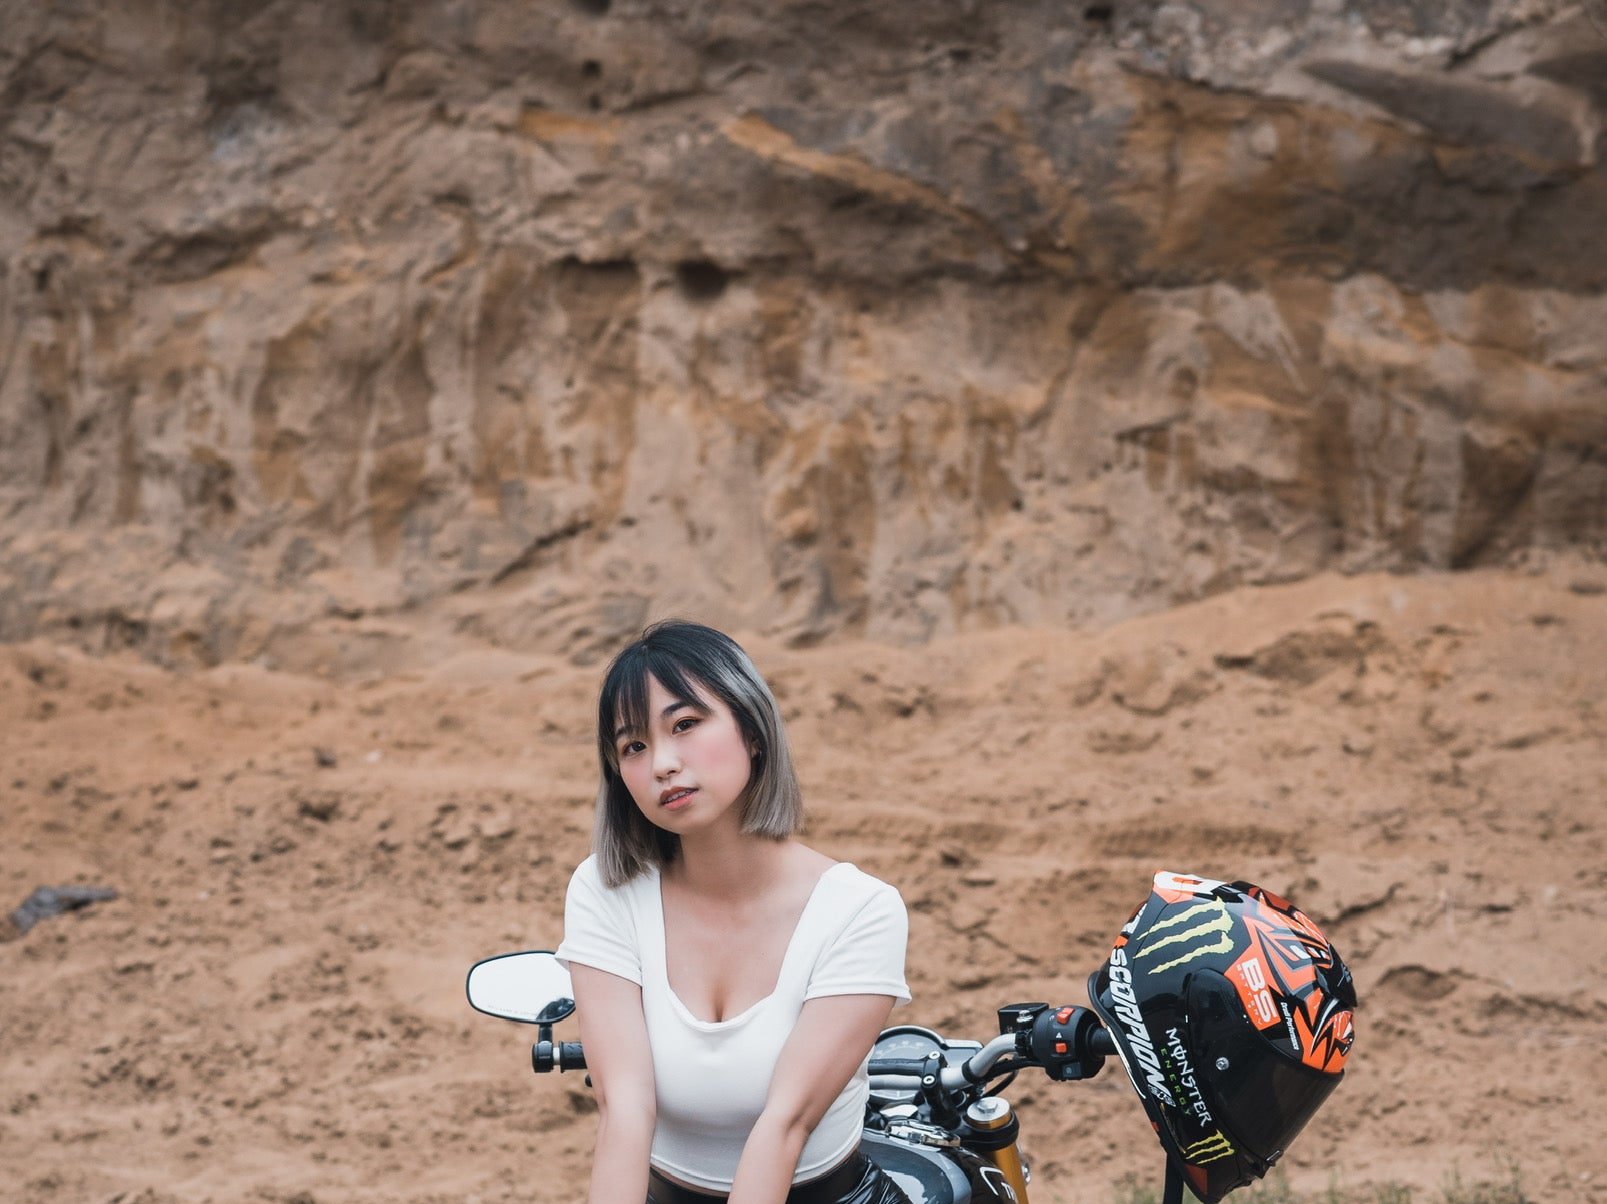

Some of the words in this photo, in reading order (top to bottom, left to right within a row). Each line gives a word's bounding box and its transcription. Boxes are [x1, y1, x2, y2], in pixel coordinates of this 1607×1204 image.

[1109, 949, 1172, 1098] SCORPION
[1241, 957, 1277, 1022] BS
[1160, 1048, 1192, 1115] ENERGY
[1165, 1027, 1212, 1127] MONSTER
